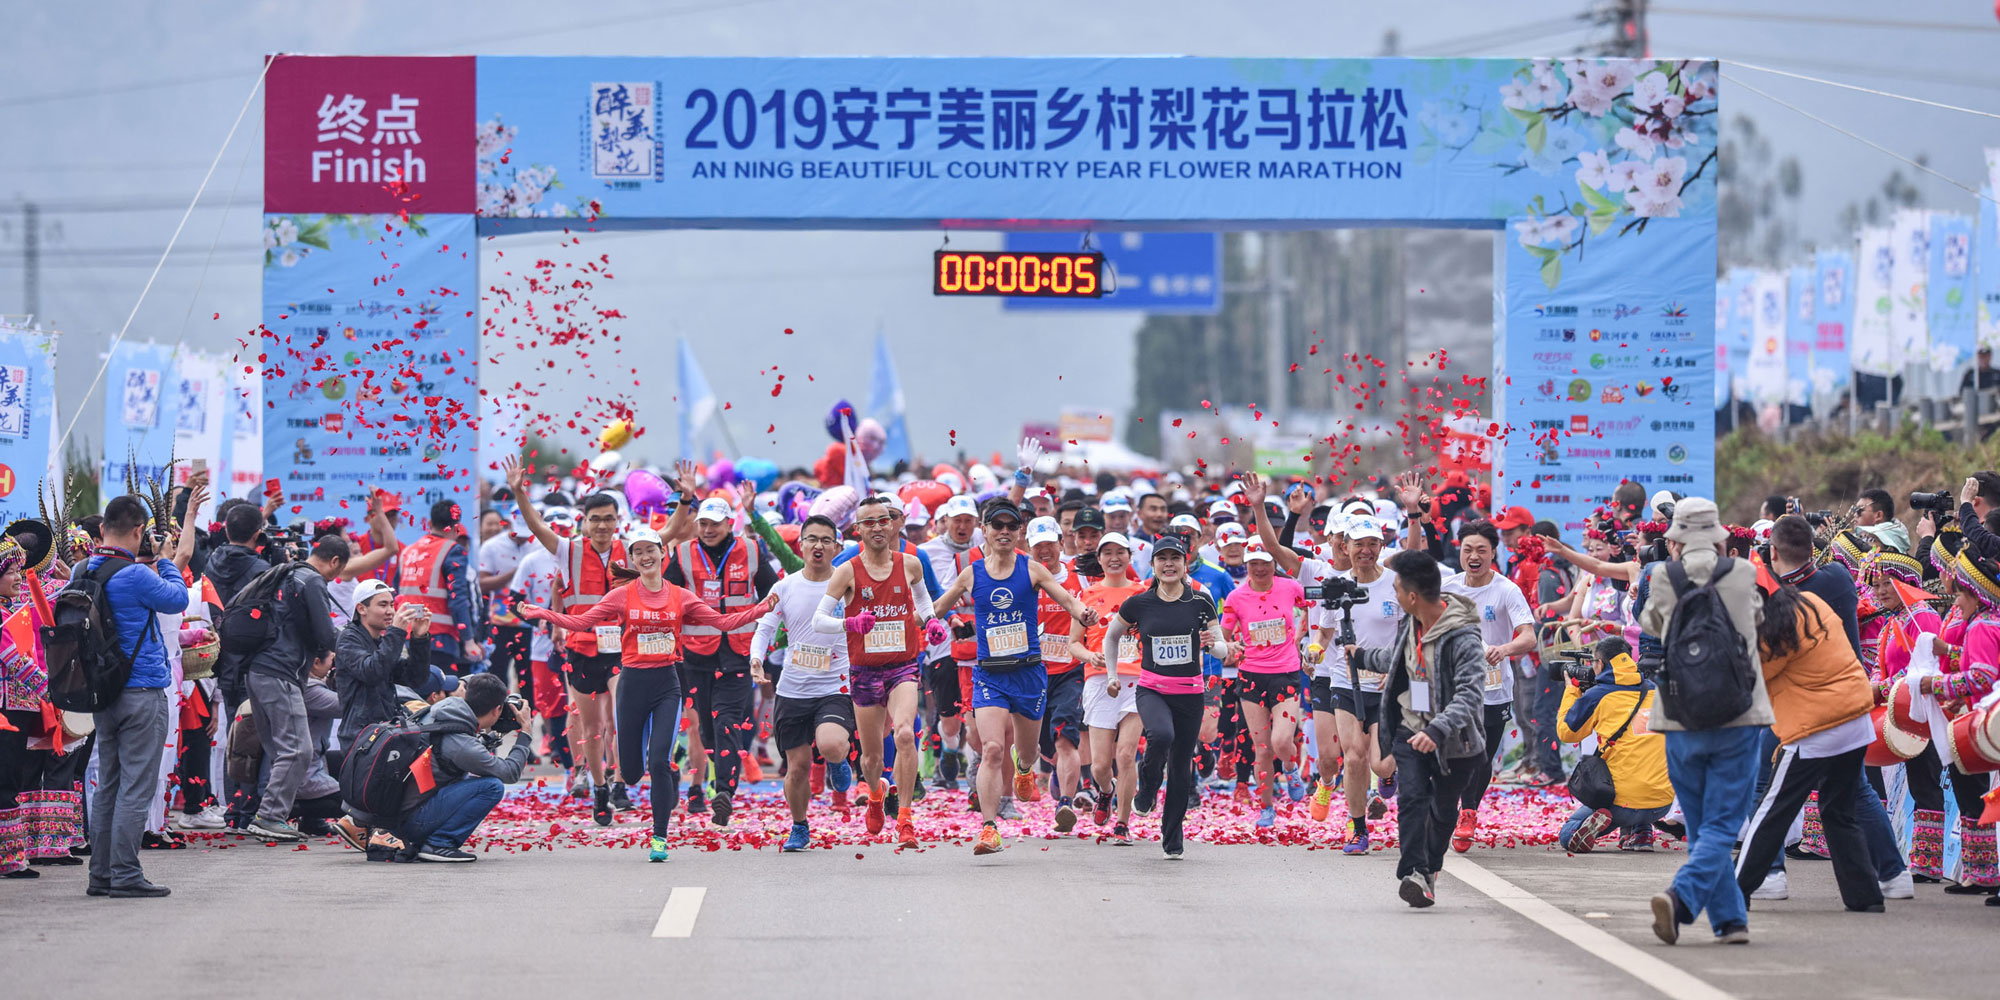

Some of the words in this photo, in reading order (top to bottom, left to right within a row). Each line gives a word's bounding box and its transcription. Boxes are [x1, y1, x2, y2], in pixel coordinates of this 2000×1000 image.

[317, 95, 421, 144] 终点
[685, 87, 1408, 150] 2019安宁美丽乡村梨花马拉松
[312, 149, 426, 183] Finish
[692, 161, 727, 179] AN
[734, 161, 794, 179] NING
[802, 161, 940, 179] BEAUTIFUL
[946, 161, 1069, 179] COUNTRY
[1077, 161, 1141, 179] PEAR
[1149, 161, 1250, 179] FLOWER
[1258, 161, 1402, 179] MARATHON
[940, 255, 1096, 294] 00:00:05
[870, 631, 900, 646] 0046
[994, 633, 1023, 650] 0079
[797, 652, 825, 668] 0001
[1159, 646, 1187, 659] 2015
